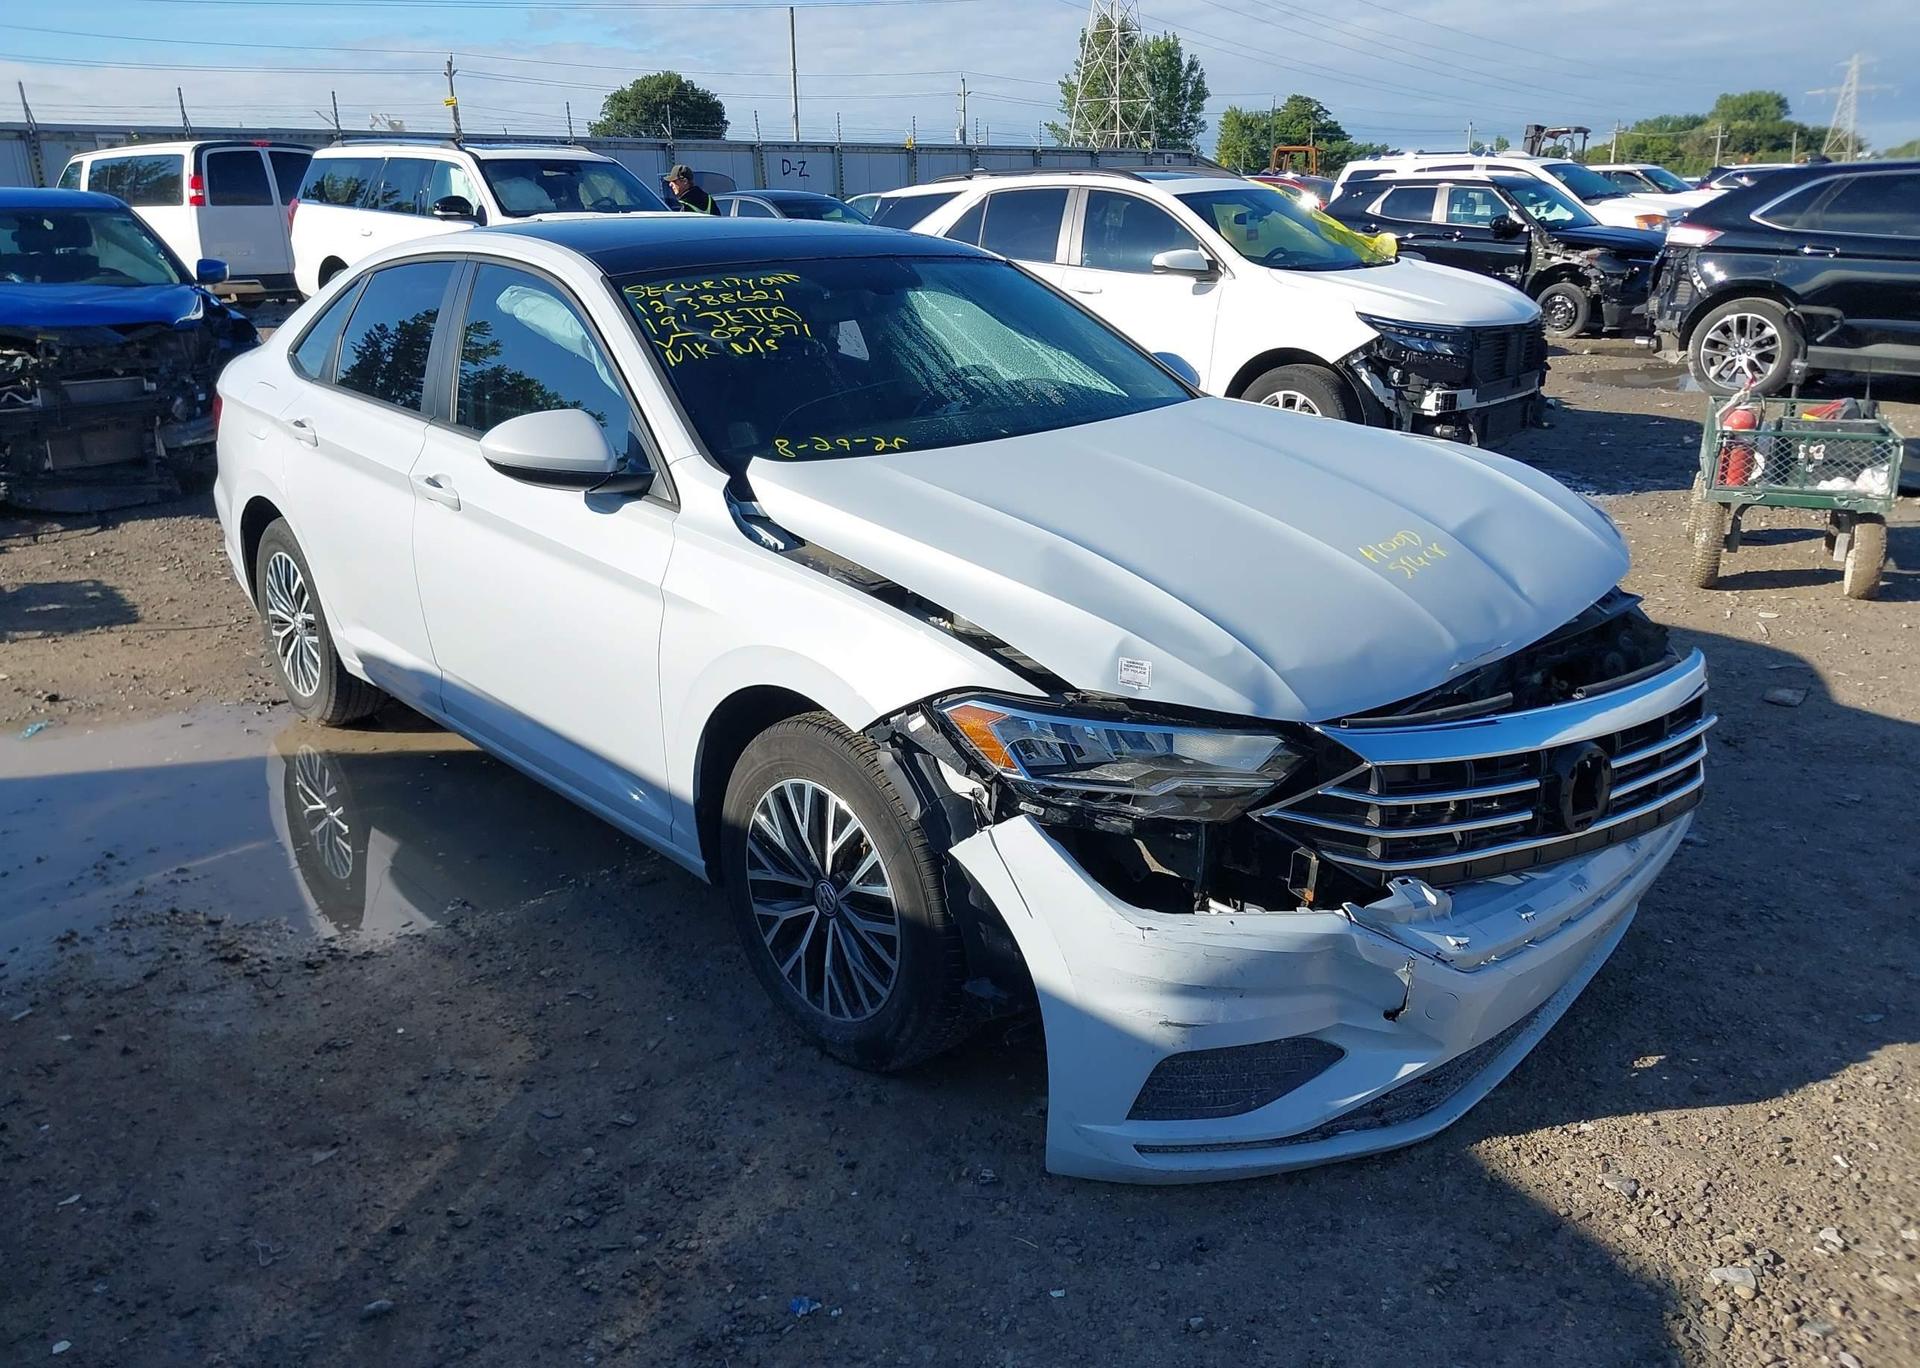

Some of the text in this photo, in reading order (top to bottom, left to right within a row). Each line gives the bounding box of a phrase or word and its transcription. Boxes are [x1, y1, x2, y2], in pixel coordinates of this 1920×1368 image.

[782, 157, 810, 177] D-Z
[623, 278, 756, 300] SECURITY
[695, 306, 803, 328] JETTA
